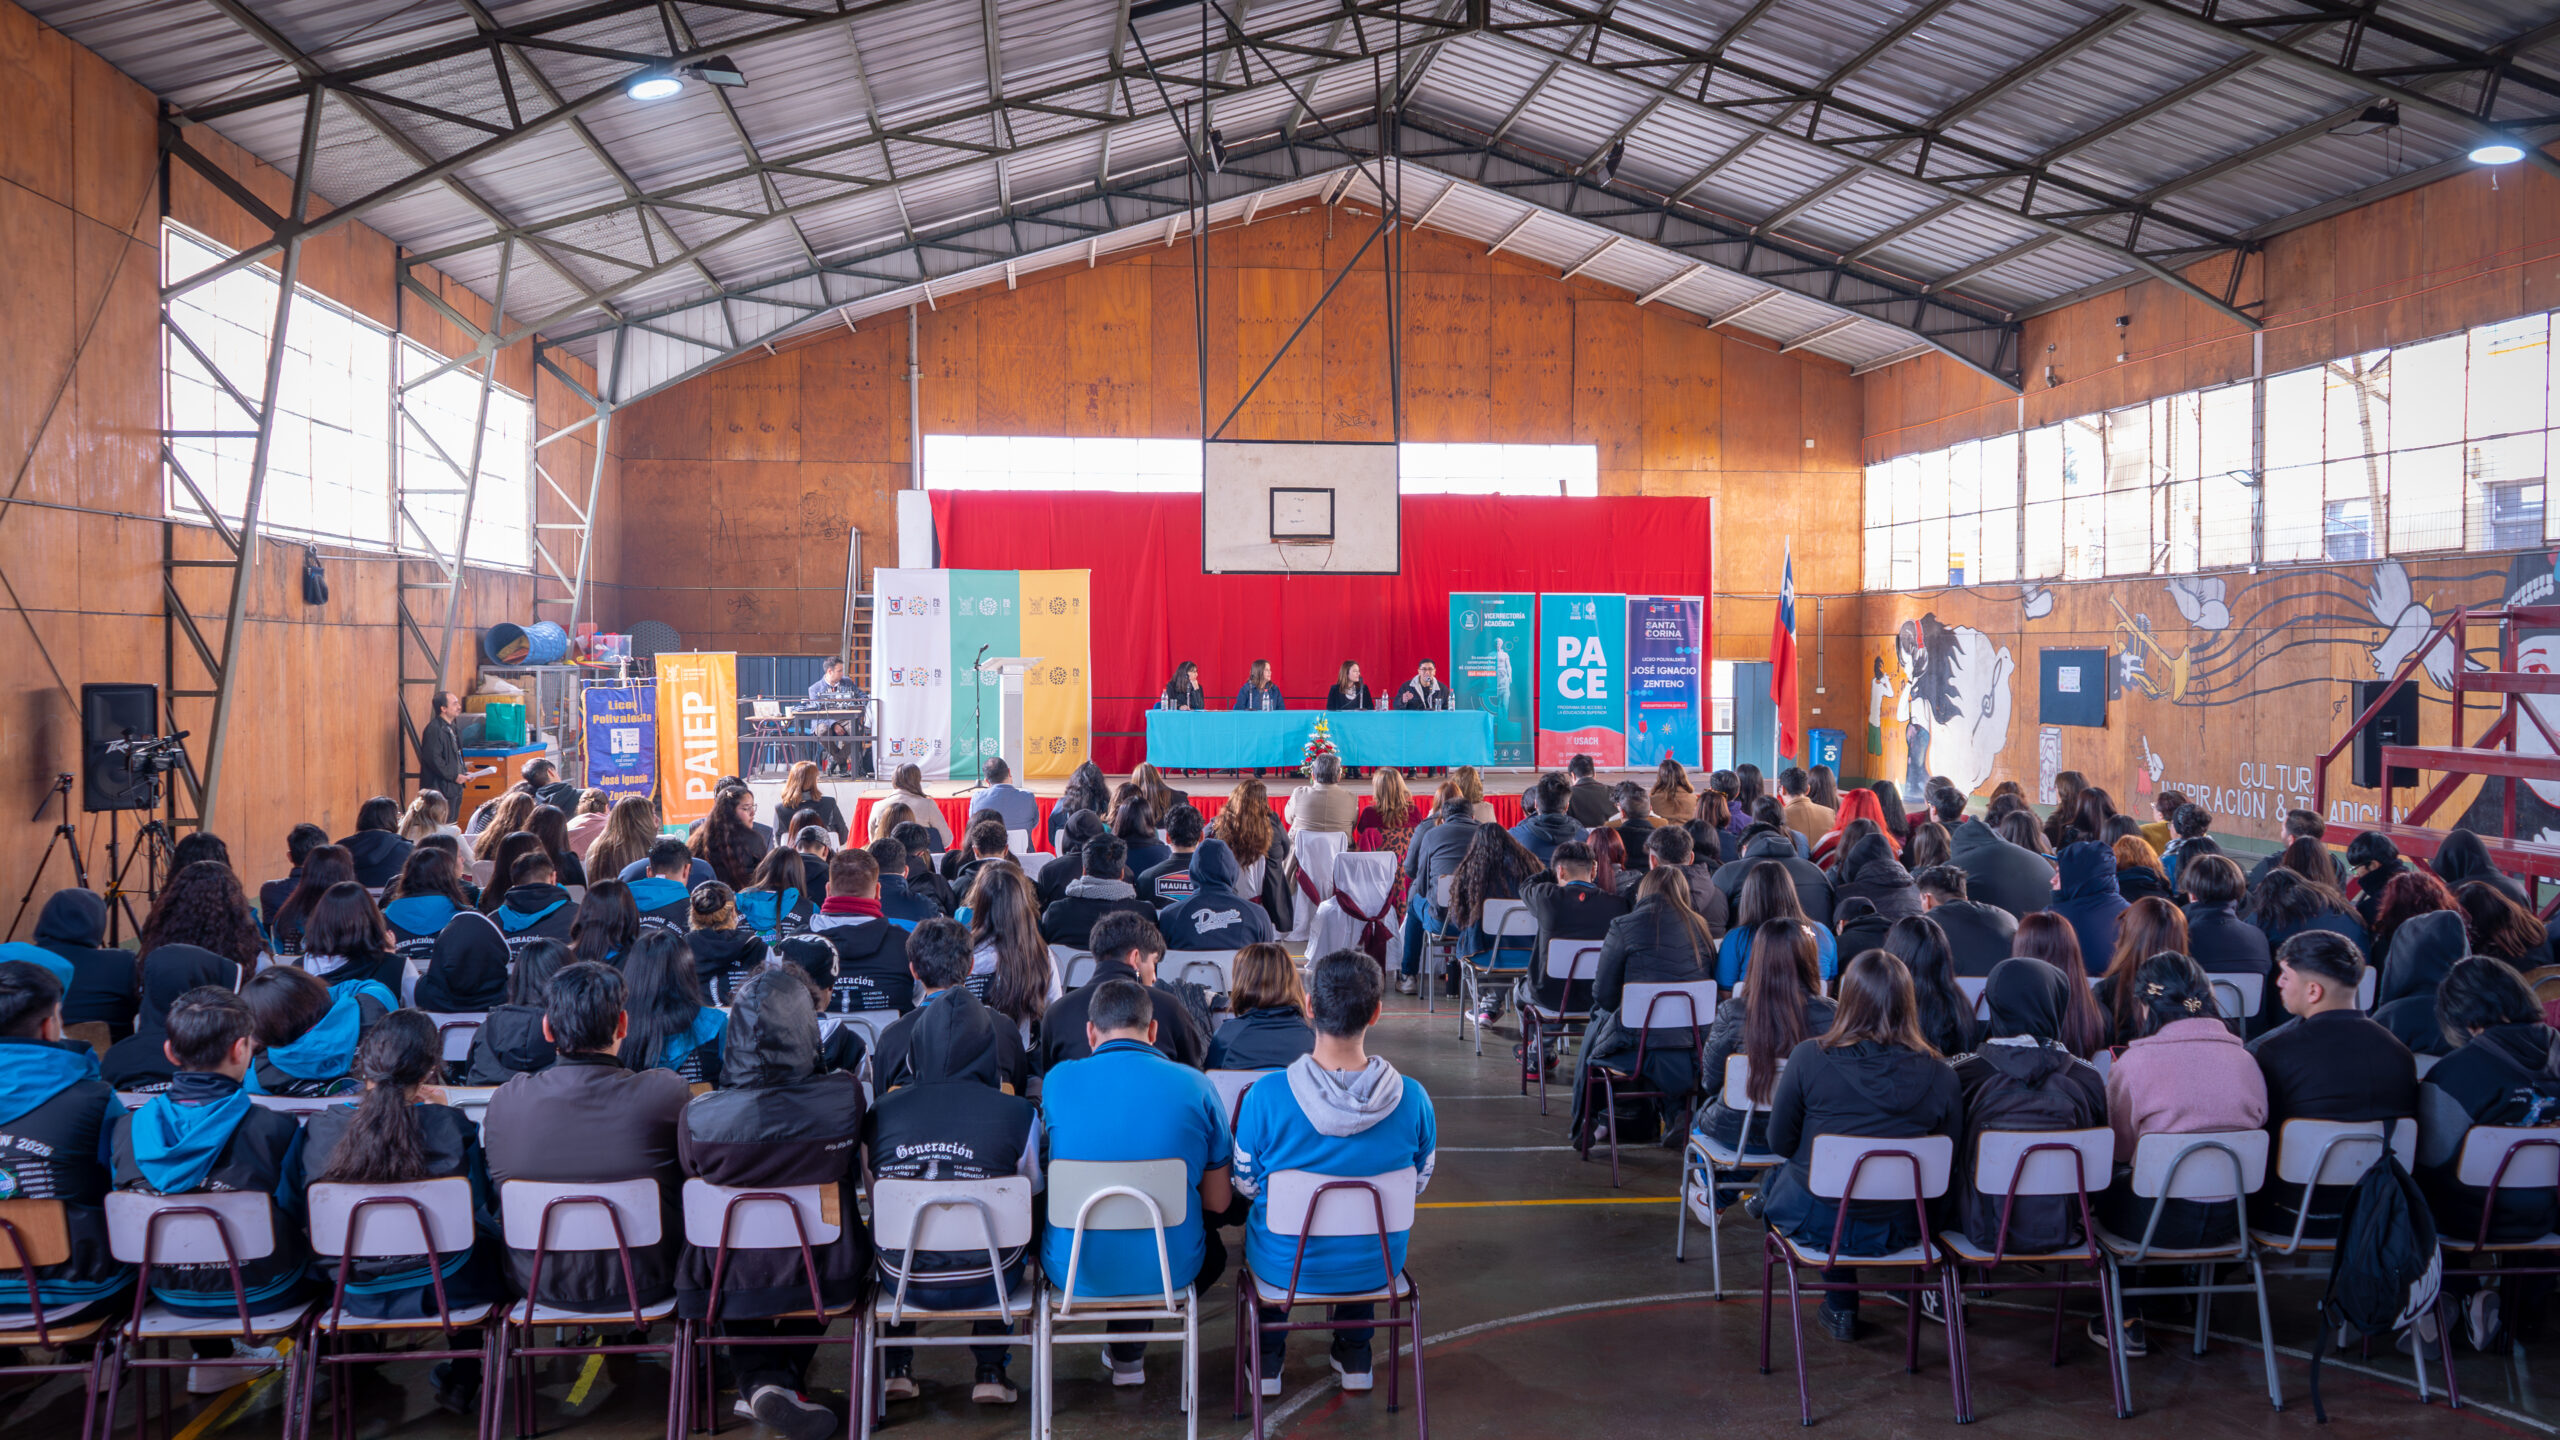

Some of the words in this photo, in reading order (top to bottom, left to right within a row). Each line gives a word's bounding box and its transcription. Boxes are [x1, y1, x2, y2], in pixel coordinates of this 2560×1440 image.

[1645, 621, 1676, 629] SANTA
[1645, 629, 1682, 637] CORINA
[1558, 636, 1607, 667] PA
[1632, 665, 1655, 675] JOSÉ
[1657, 667, 1697, 675] IGNACIO
[1558, 668, 1607, 699] CE
[1643, 680, 1685, 688] ZENTENO
[593, 713, 652, 724] Polivalente
[682, 691, 718, 800] PAIEP
[1574, 737, 1599, 745] USACH
[600, 774, 619, 785] José
[2239, 762, 2315, 795] CULTUR
[2275, 793, 2287, 822] &
[2295, 796, 2409, 824] TADICIN
[786, 912, 802, 922] 025
[396, 936, 435, 949] NERACIÓN
[505, 935, 543, 944] NERACIÓ
[835, 976, 875, 987] eración
[896, 1142, 974, 1159] Generación
